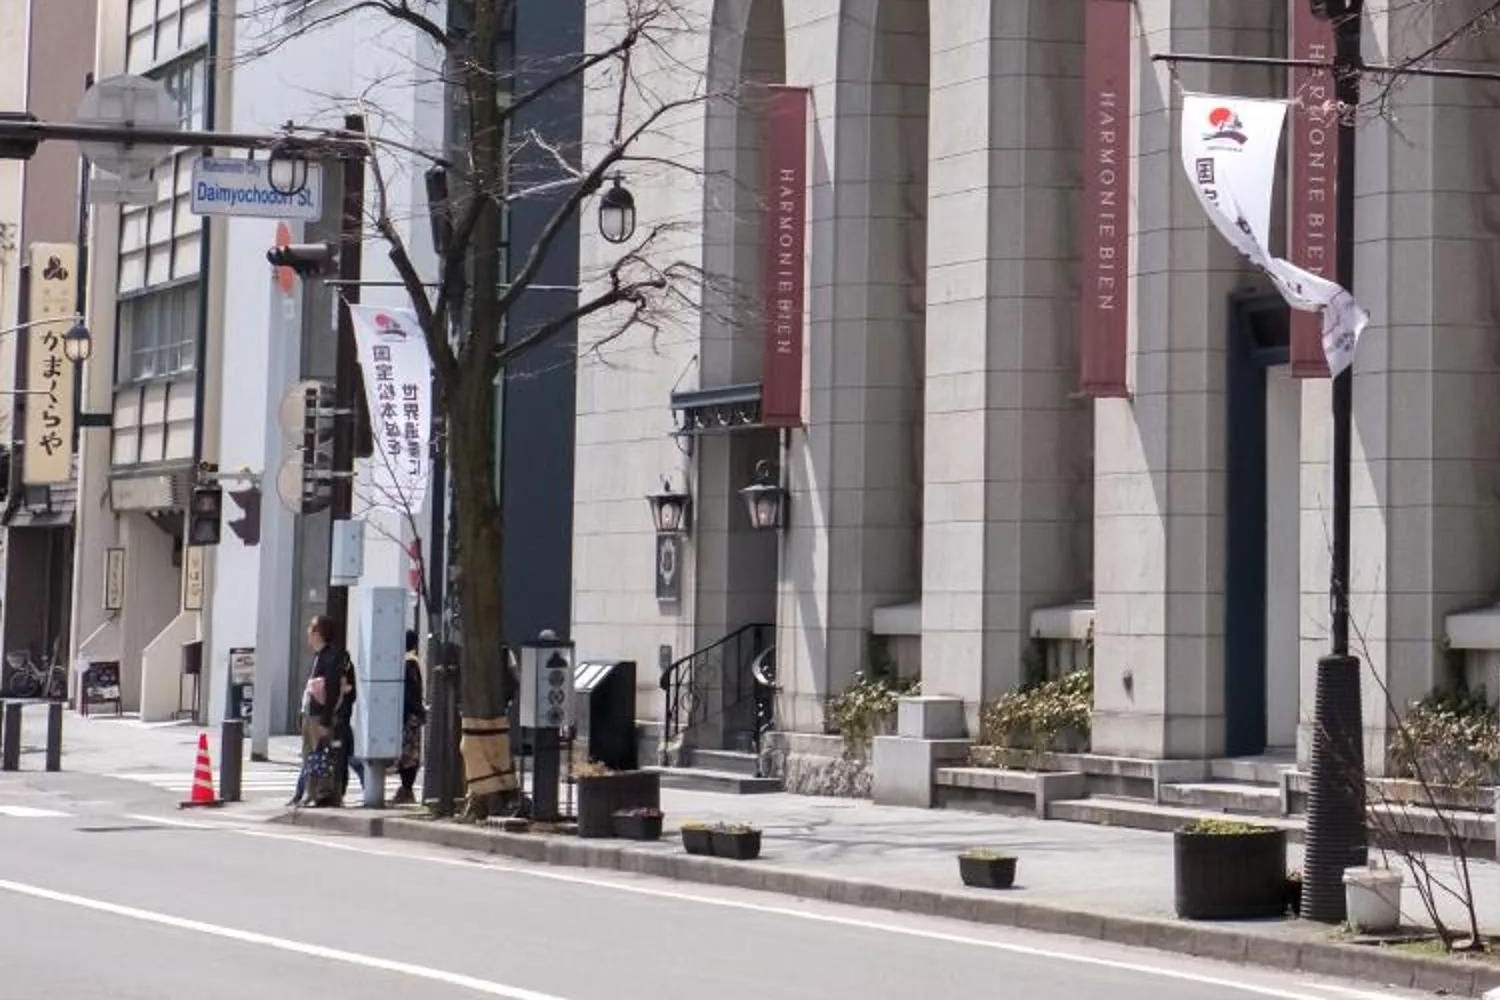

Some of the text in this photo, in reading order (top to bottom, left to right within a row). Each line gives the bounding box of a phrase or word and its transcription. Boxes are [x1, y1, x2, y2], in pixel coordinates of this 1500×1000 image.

[777, 168, 795, 354] HARMONIE BIEN
[1099, 92, 1115, 310] HARMONIE BIEN
[40, 331, 65, 456] かまくらや
